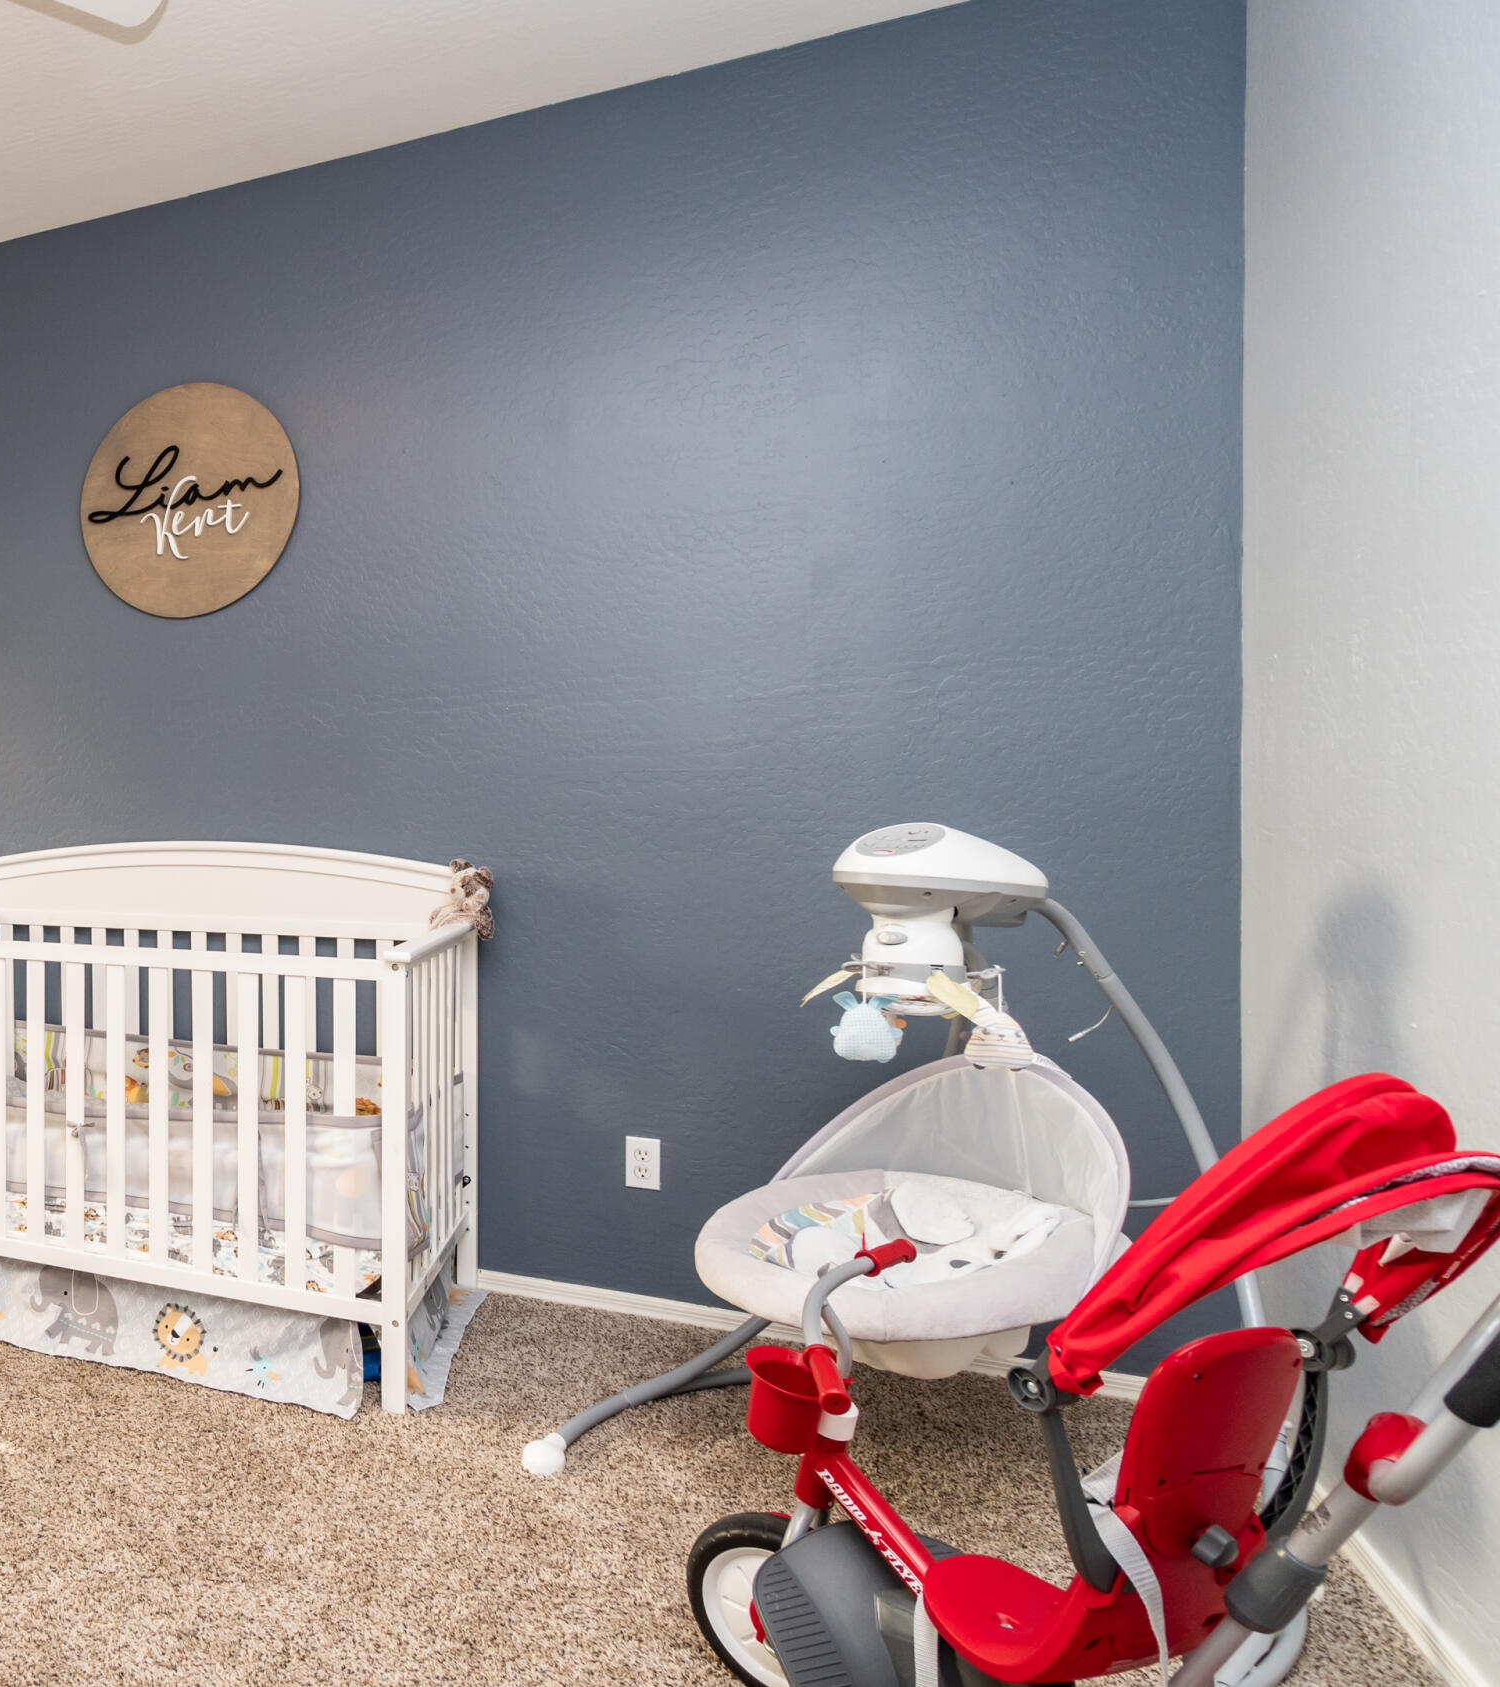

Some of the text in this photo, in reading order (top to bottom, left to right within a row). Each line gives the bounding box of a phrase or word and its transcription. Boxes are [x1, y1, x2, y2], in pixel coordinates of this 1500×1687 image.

[88, 446, 283, 523] Liam
[140, 476, 249, 560] Kent
[815, 1469, 924, 1597] RADIO FLYE
